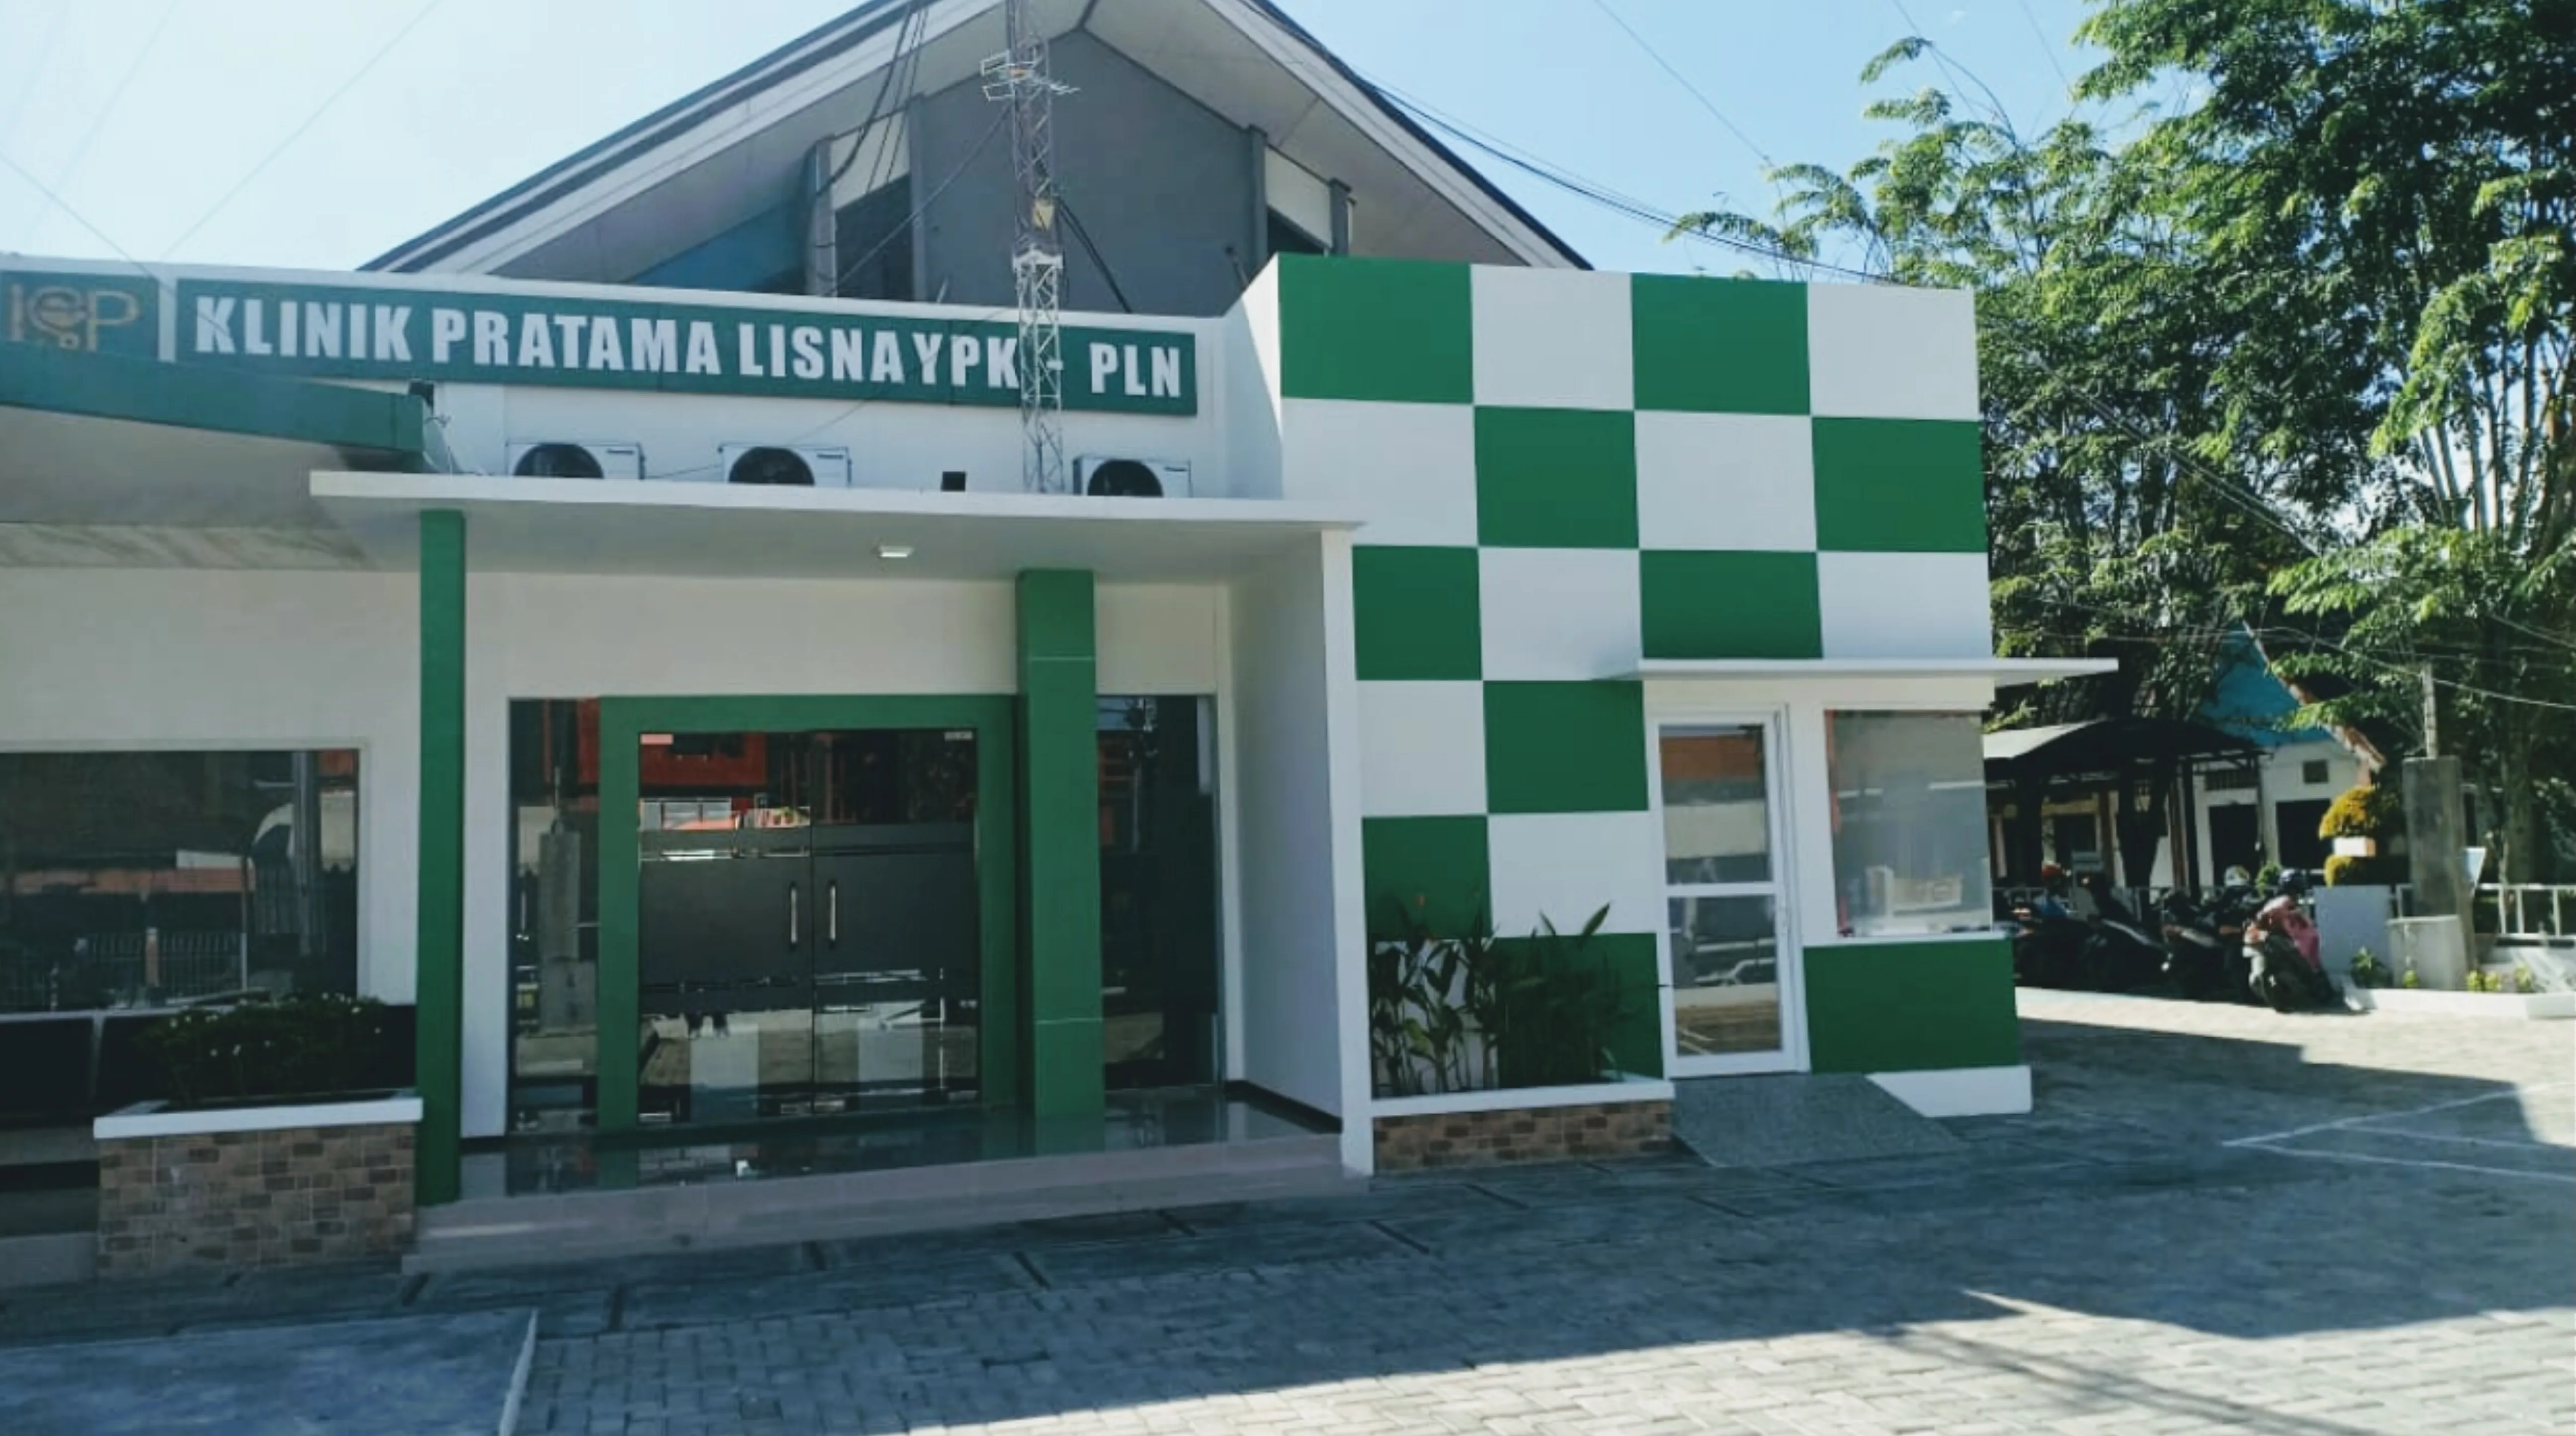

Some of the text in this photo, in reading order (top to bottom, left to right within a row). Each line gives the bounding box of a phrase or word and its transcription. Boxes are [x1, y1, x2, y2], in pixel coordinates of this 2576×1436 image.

[196, 297, 412, 362] KLINIK
[432, 308, 721, 375] PRATAMA
[1090, 343, 1180, 397] PLN
